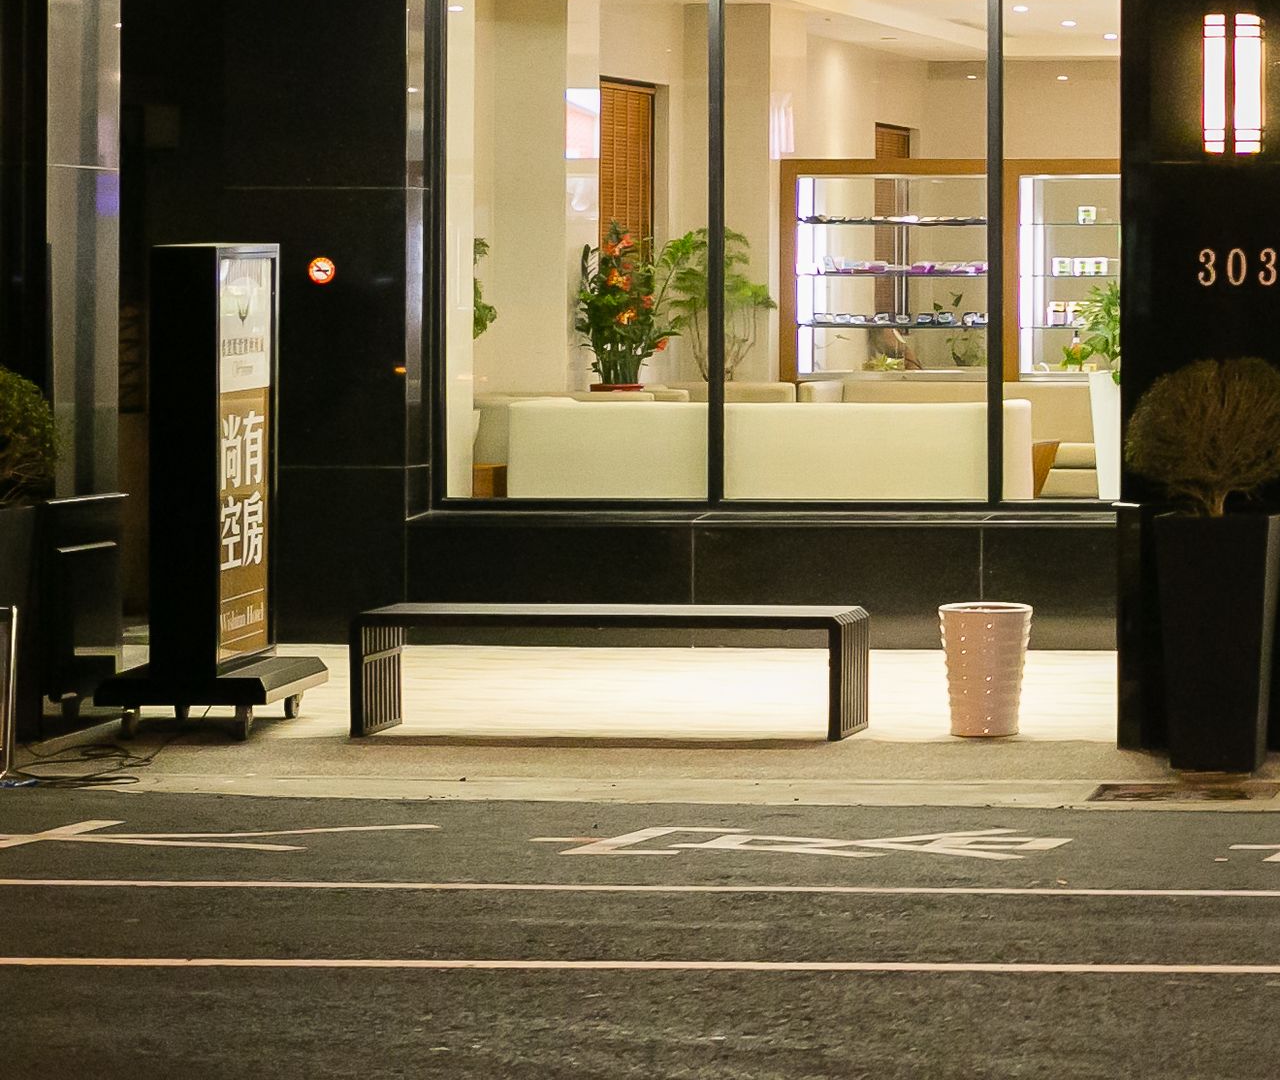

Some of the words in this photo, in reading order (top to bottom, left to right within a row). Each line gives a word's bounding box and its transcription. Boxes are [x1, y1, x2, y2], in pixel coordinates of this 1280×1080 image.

[1198, 247, 1277, 287] 303
[221, 410, 265, 490] 尚有
[220, 491, 264, 571] 空房
